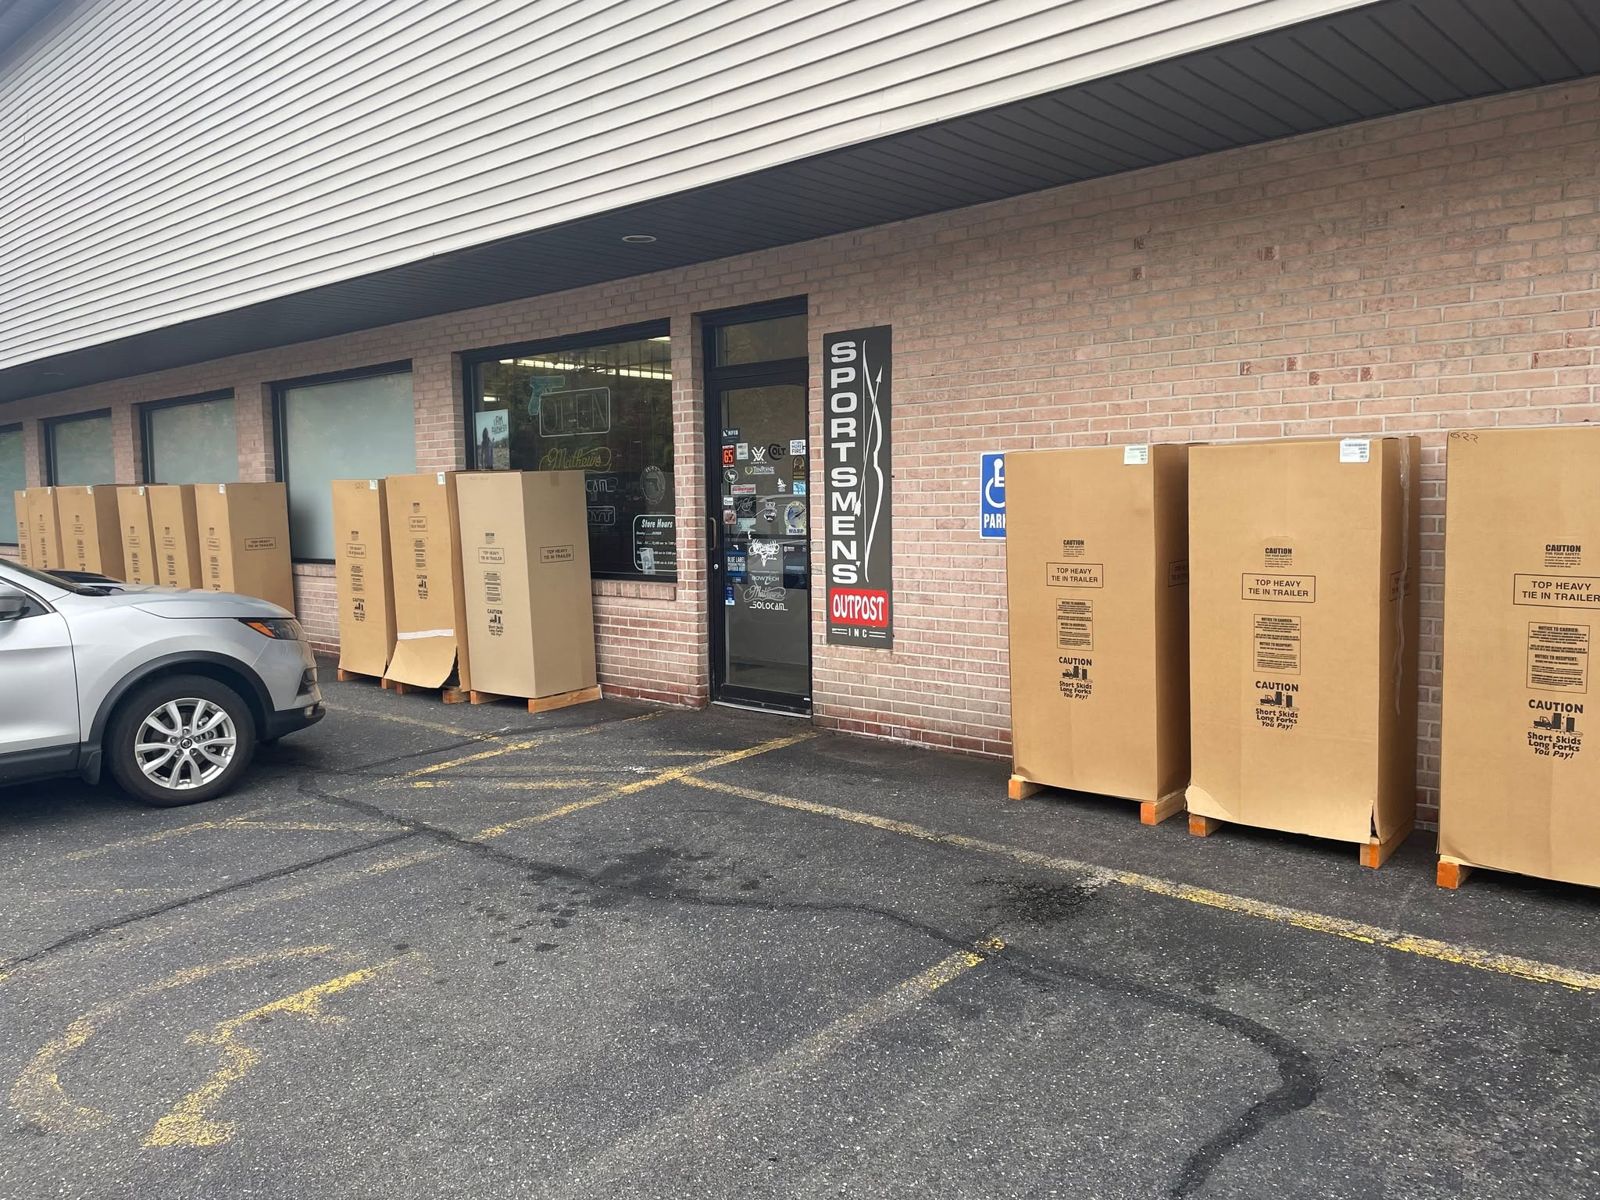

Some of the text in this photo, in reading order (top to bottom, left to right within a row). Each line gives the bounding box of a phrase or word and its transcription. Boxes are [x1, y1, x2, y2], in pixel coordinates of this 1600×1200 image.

[768, 444, 786, 460] COLT
[641, 518, 672, 528] Store Hours
[984, 513, 1005, 528] PAR
[1545, 544, 1581, 552] CAUTION
[1556, 582, 1591, 590] HEAVY
[1522, 591, 1537, 599] TIE
[1554, 593, 1600, 602] TRAILER
[749, 601, 788, 611] SOLOCAM
[833, 594, 885, 621] OUTPOST
[848, 628, 867, 638] INC
[1059, 656, 1092, 666] CAUTION
[1256, 681, 1298, 691] CAUTION
[1528, 699, 1583, 713] CAUTION
[1256, 708, 1276, 716] Short
[1528, 732, 1581, 745] Short Skids
[1528, 739, 1580, 752] Long Forks
[1553, 750, 1574, 760] Pay!
